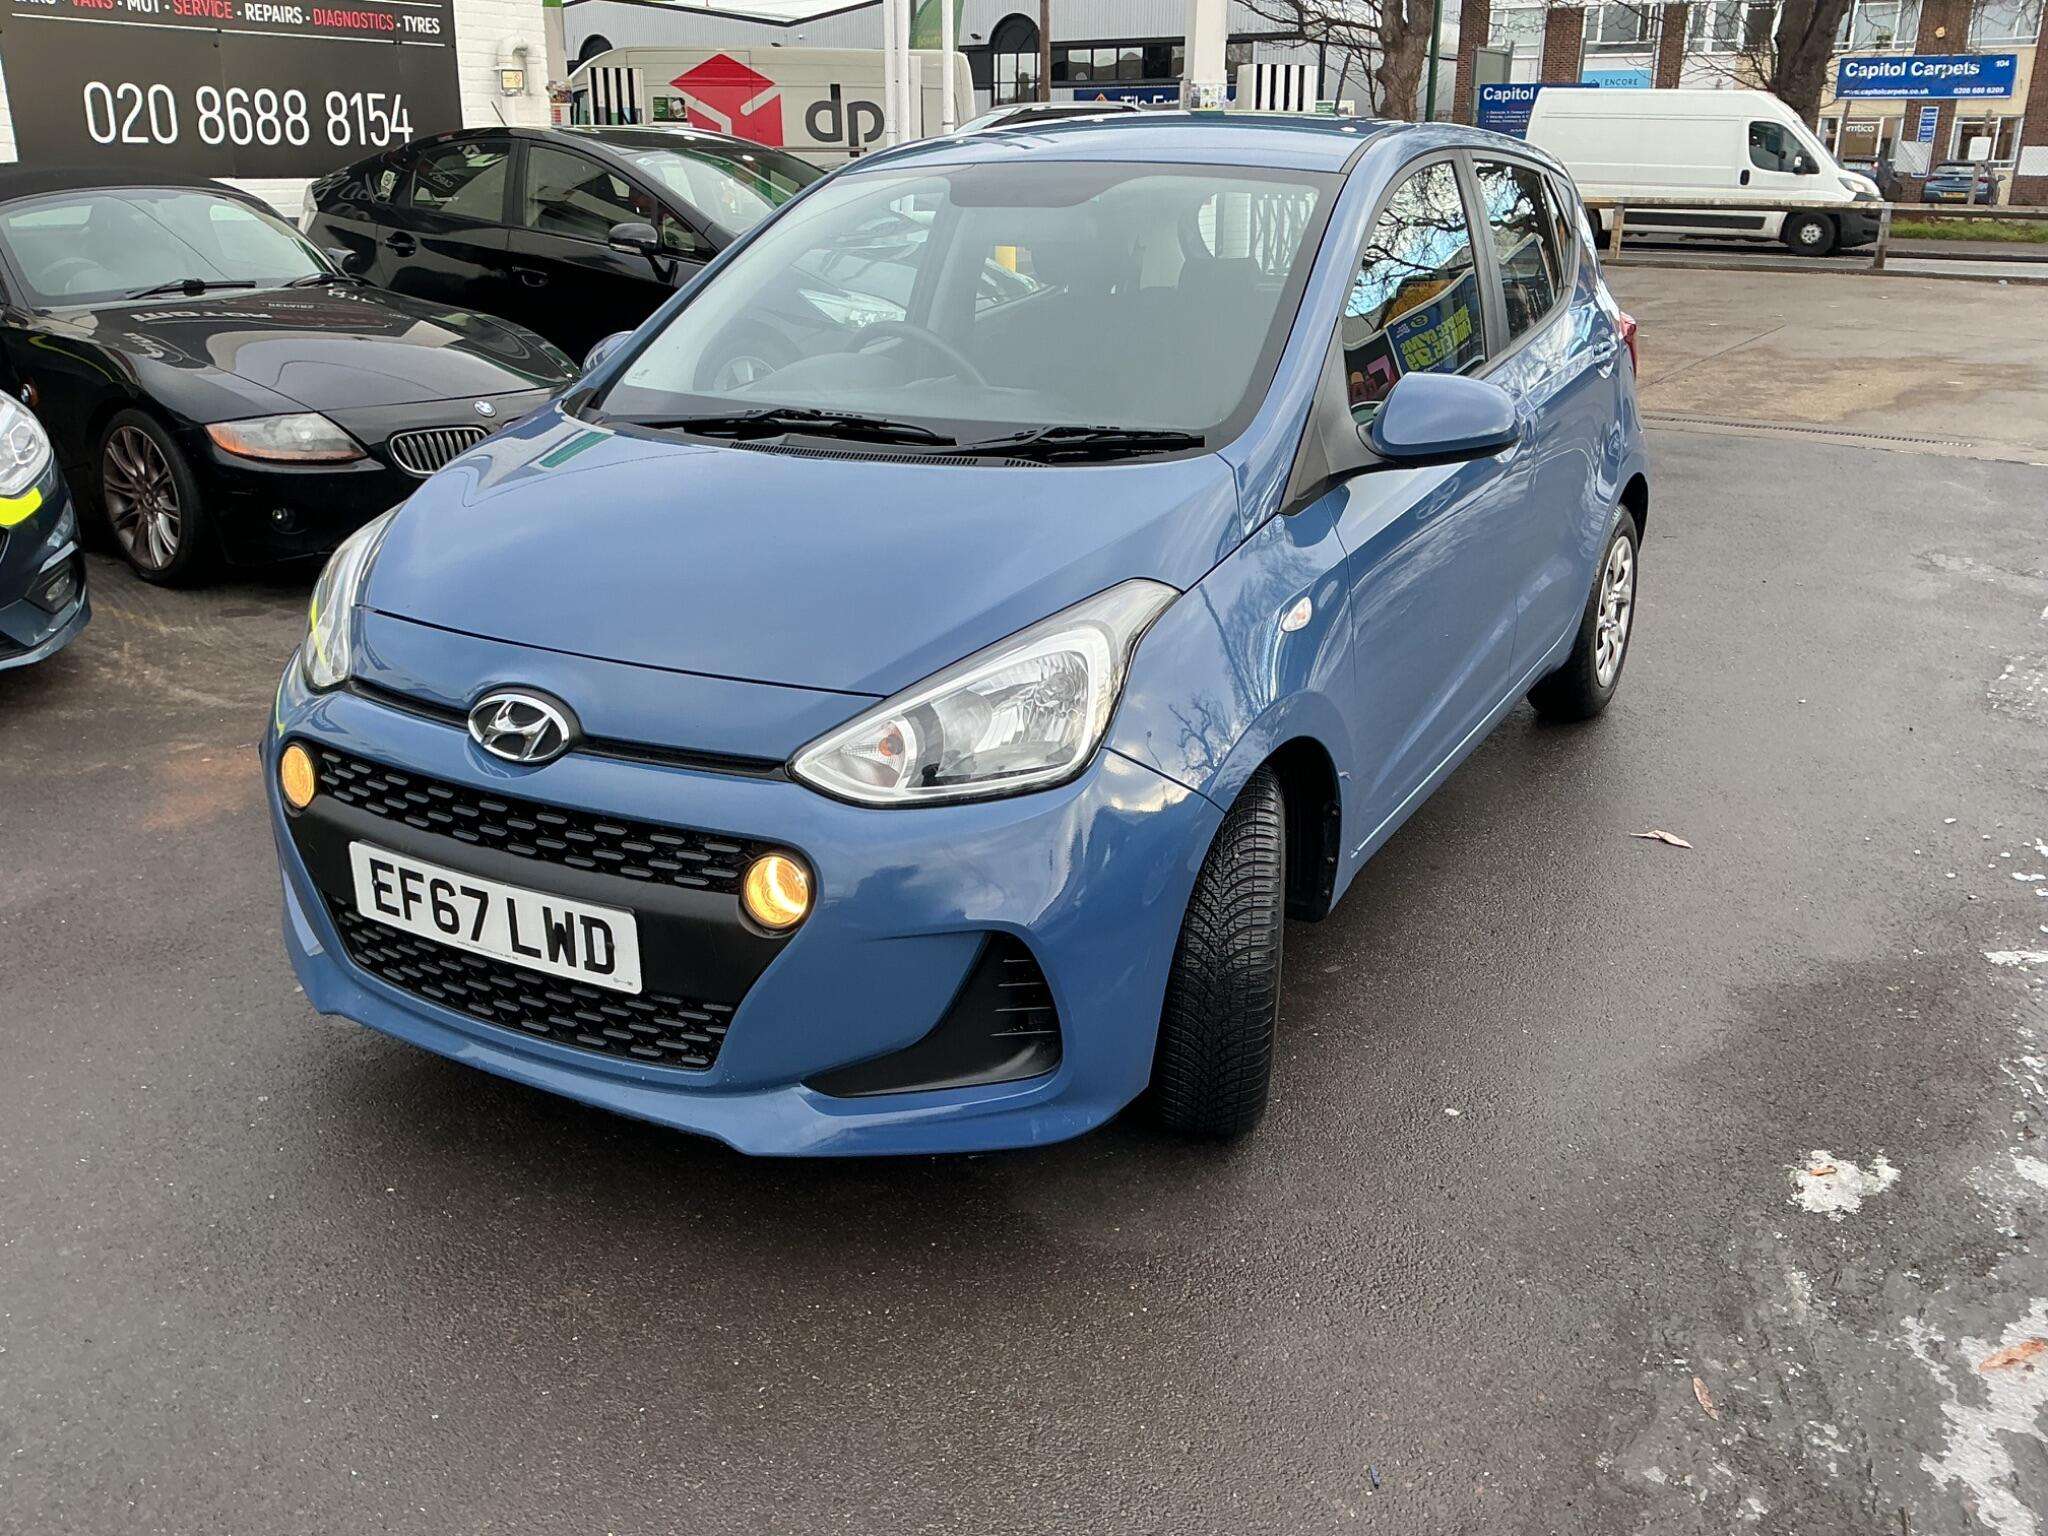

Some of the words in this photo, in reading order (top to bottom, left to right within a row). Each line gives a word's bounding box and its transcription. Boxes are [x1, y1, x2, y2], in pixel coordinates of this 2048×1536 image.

[174, 0, 233, 19] SERVICE
[245, 3, 303, 24] REPAIRS
[313, 8, 394, 31] DIAGNOSTICS
[403, 16, 440, 34] TYRES
[1845, 61, 1906, 79] Capitol
[1911, 61, 1980, 78] Carpets
[1995, 59, 2010, 68] 104
[1483, 87, 1534, 103] Capitol
[1604, 78, 1638, 86] ENCORE
[83, 81, 178, 144] 020
[195, 85, 310, 146] 8688
[325, 90, 414, 147] 8154
[805, 84, 885, 158] dp
[369, 857, 489, 942] EF67
[506, 897, 616, 975] LWD
